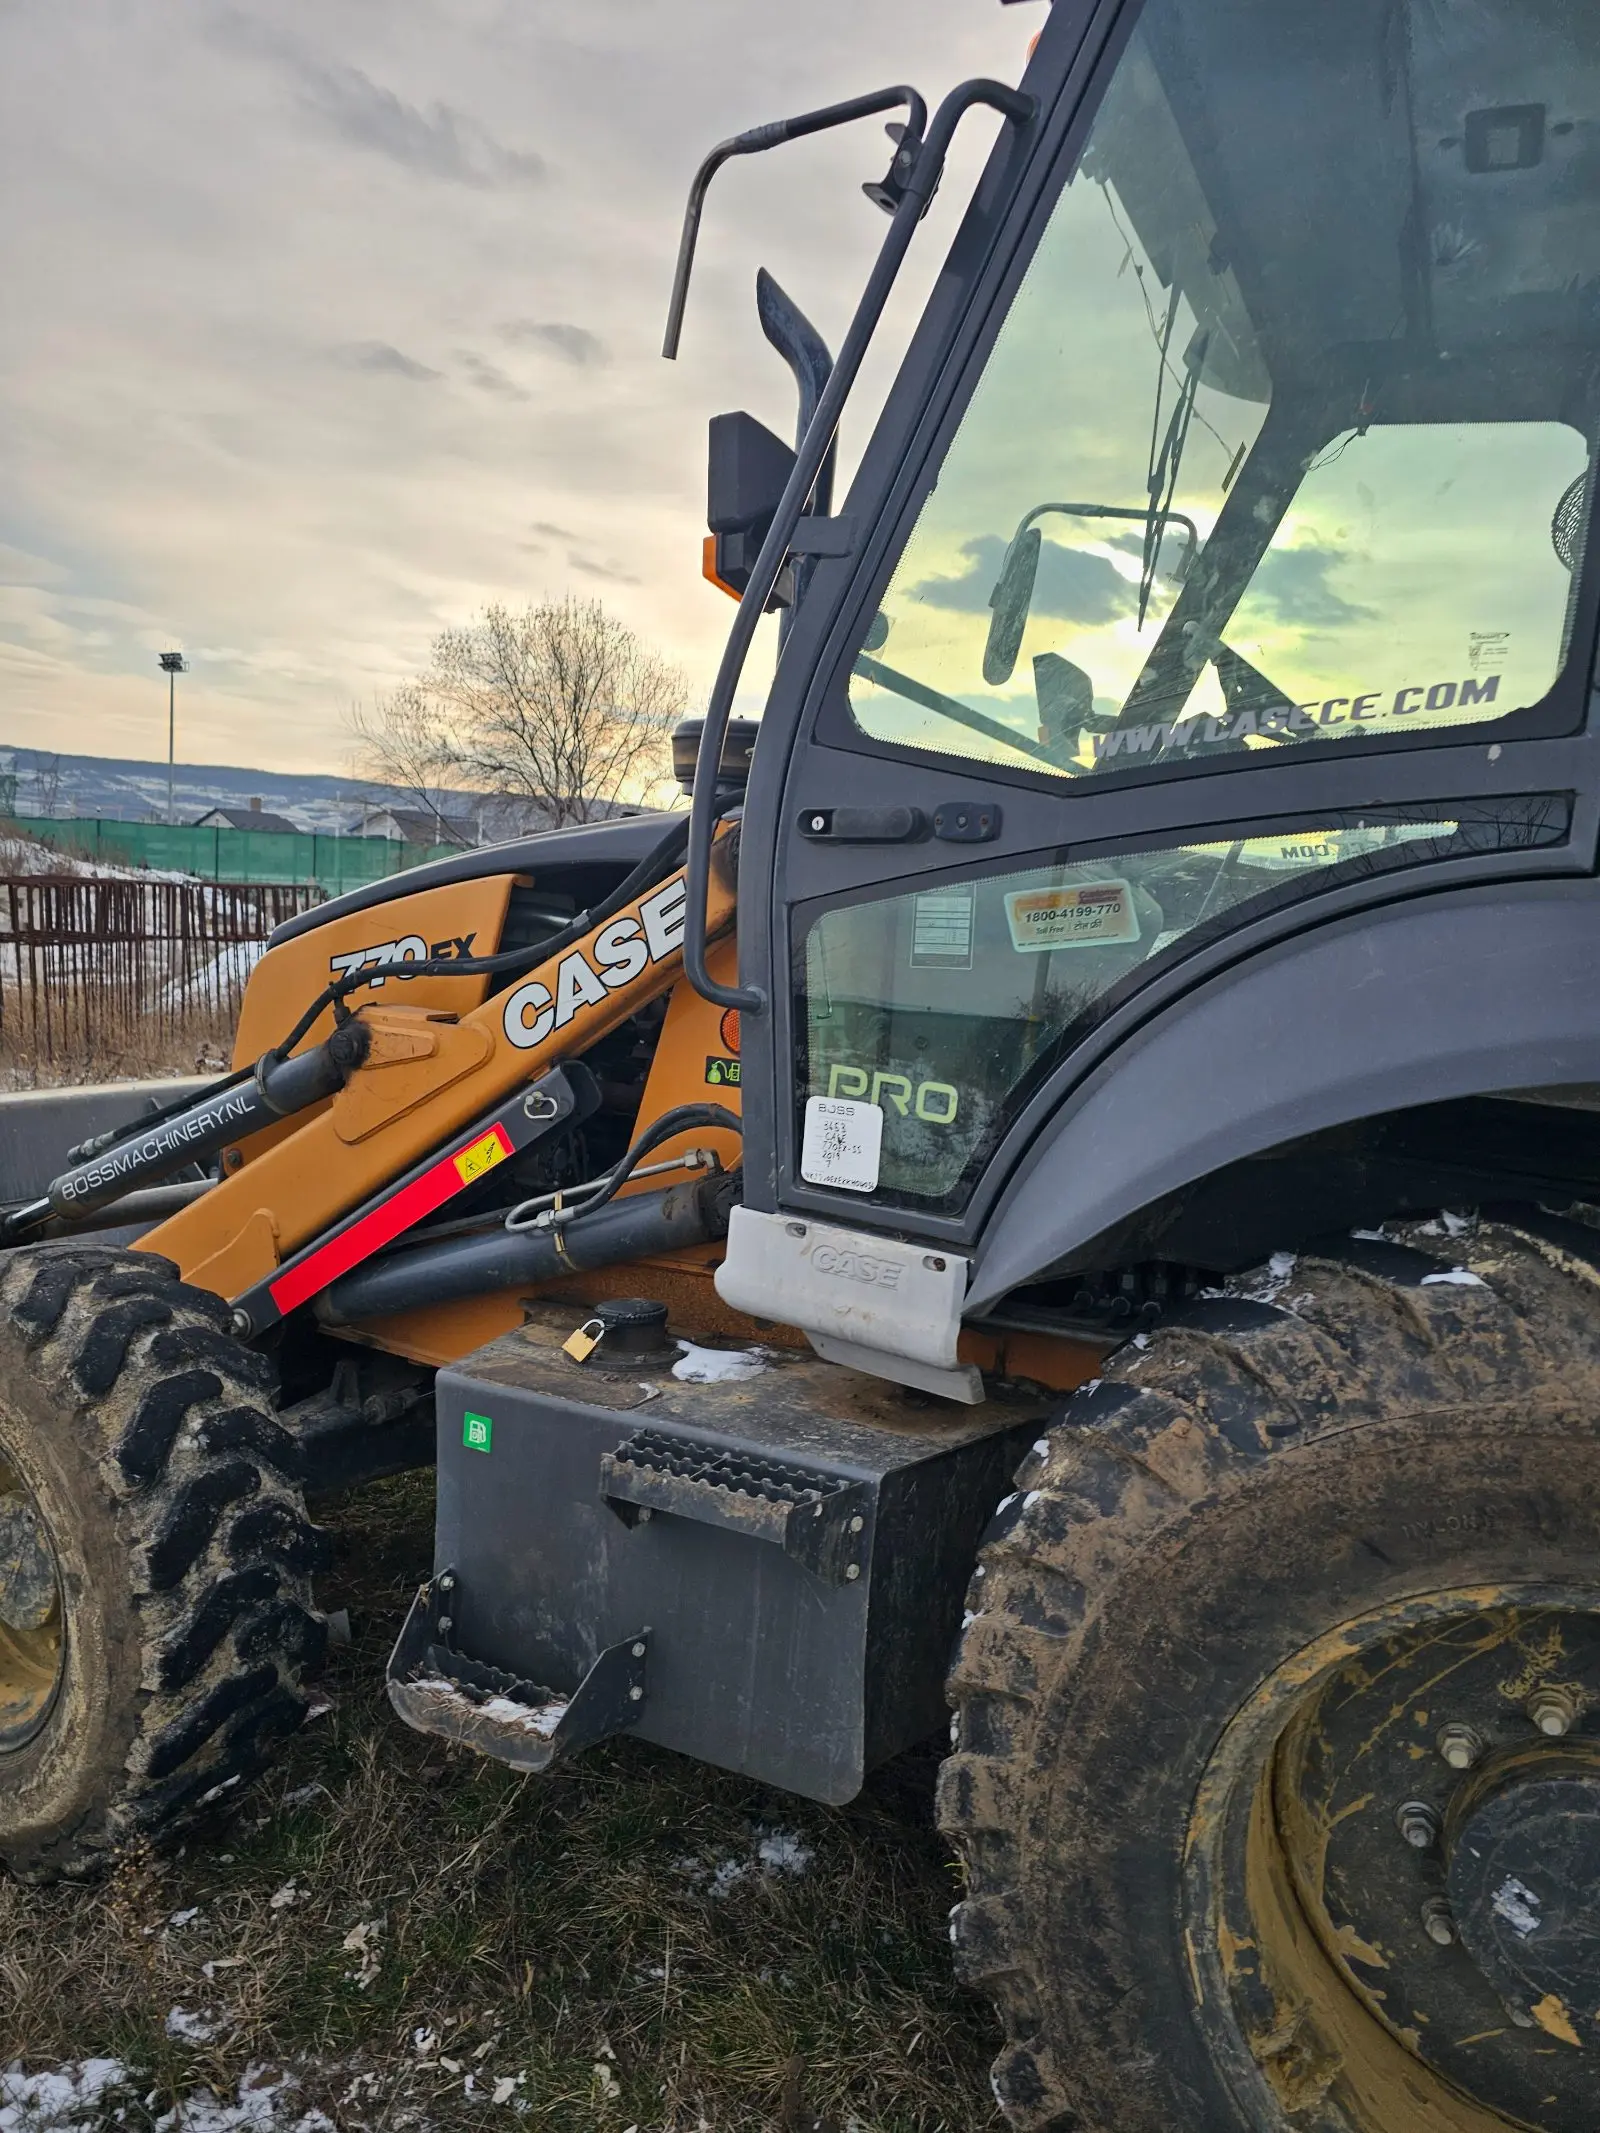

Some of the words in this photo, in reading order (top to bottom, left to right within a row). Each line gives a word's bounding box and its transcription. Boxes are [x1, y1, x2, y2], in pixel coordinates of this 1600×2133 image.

[1093, 675, 1501, 758] WWW.CASECE.COM
[1025, 903, 1121, 923] 1800-4199-770
[503, 878, 688, 1049] CASE
[828, 1064, 959, 1124] PRO
[61, 1096, 256, 1201] BOSSMACHINERY.NL
[812, 1245, 905, 1291] CASE
